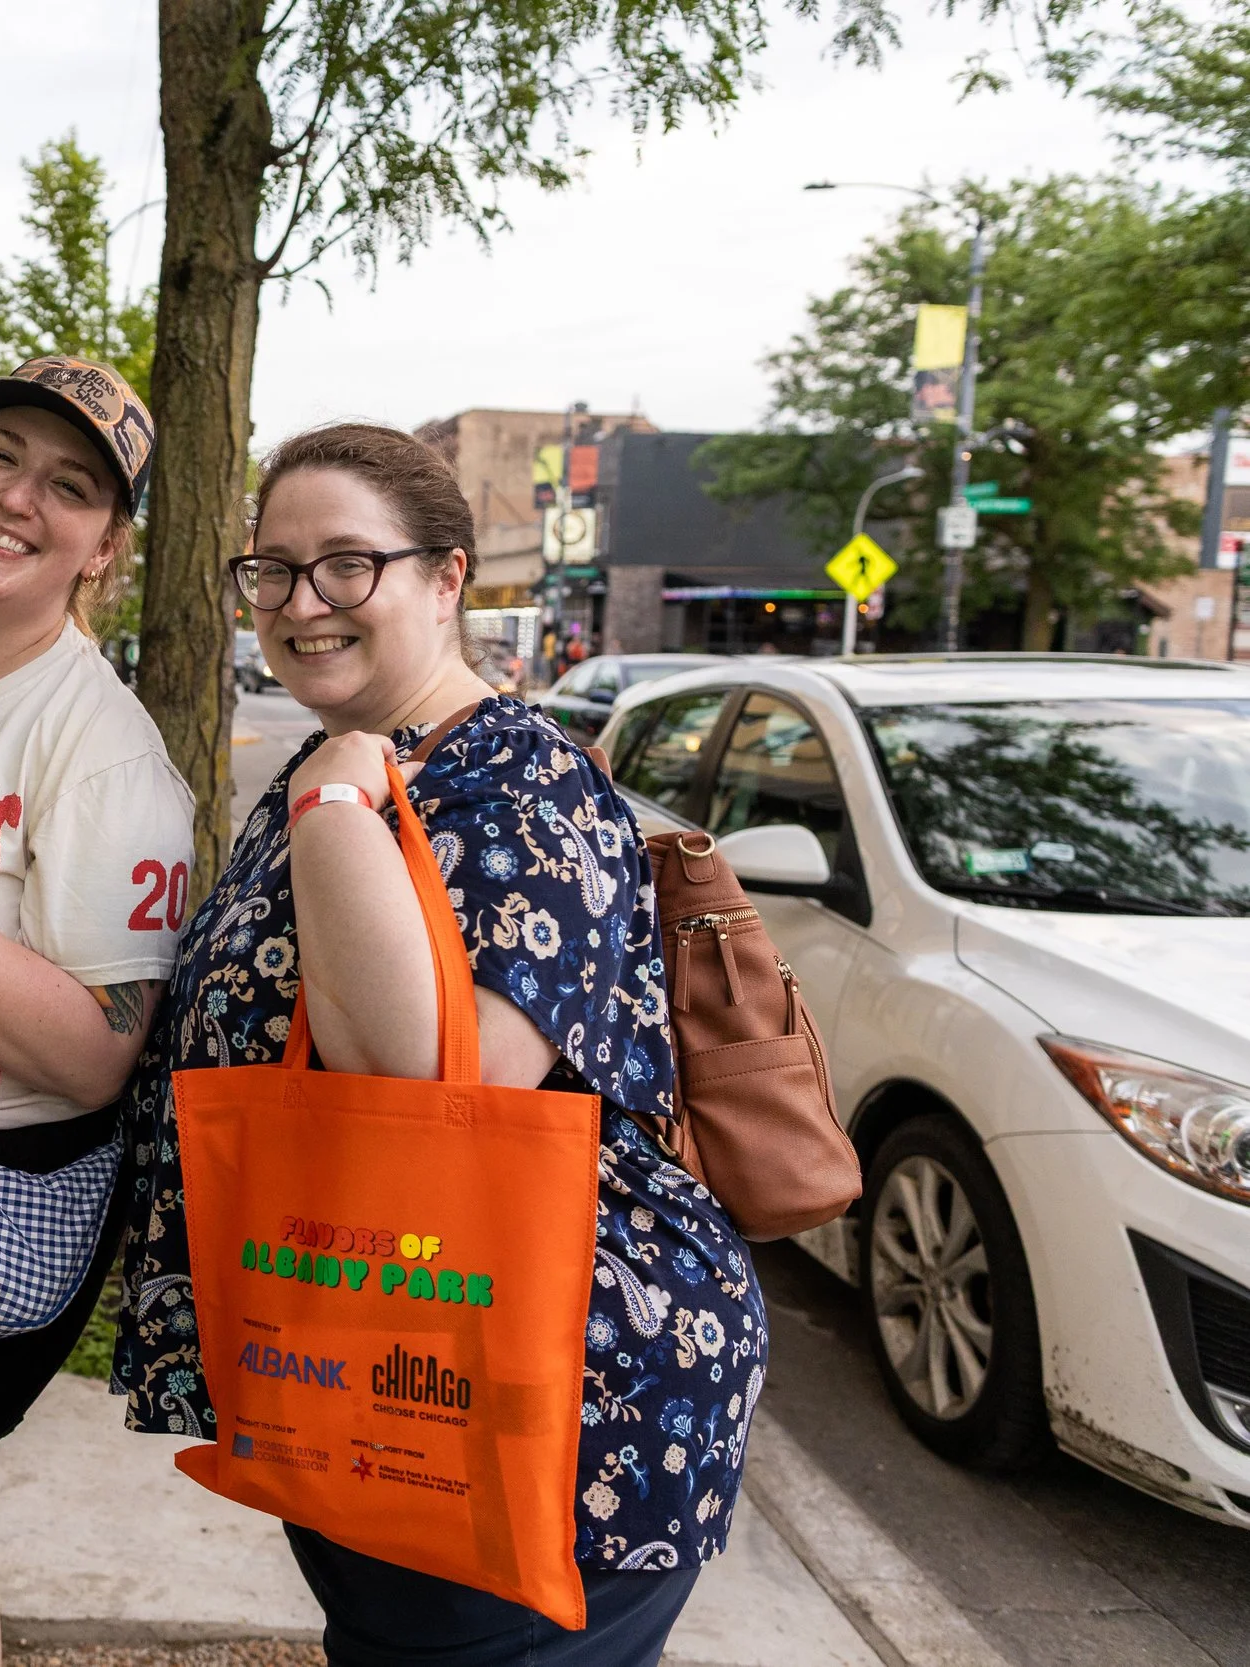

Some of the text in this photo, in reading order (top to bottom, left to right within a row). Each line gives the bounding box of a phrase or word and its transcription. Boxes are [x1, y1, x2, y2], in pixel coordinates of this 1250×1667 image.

[78, 379, 104, 398] Pro
[82, 369, 118, 397] Bass
[70, 388, 110, 422] Shops
[128, 859, 188, 932] 20
[280, 1215, 442, 1261] FLAVORS OF
[240, 1238, 494, 1308] ALBANY PARK
[272, 1325, 282, 1334] BY
[238, 1341, 347, 1391] ALBANK
[372, 1343, 472, 1410] CHICAGO
[261, 1422, 270, 1430] TO
[271, 1424, 286, 1433] YOU
[286, 1426, 297, 1434] BY
[372, 1403, 469, 1428] CHOOSE CHICAGO
[254, 1439, 330, 1462] NORTH RIVER
[254, 1450, 328, 1473] COMMISSION
[350, 1438, 425, 1460] WITH SUPPORT FROM
[378, 1464, 405, 1476] Albany
[406, 1470, 422, 1480] Park
[430, 1475, 453, 1487] Irving
[454, 1480, 471, 1490] Park
[378, 1472, 466, 1496] Special Service Area 60
